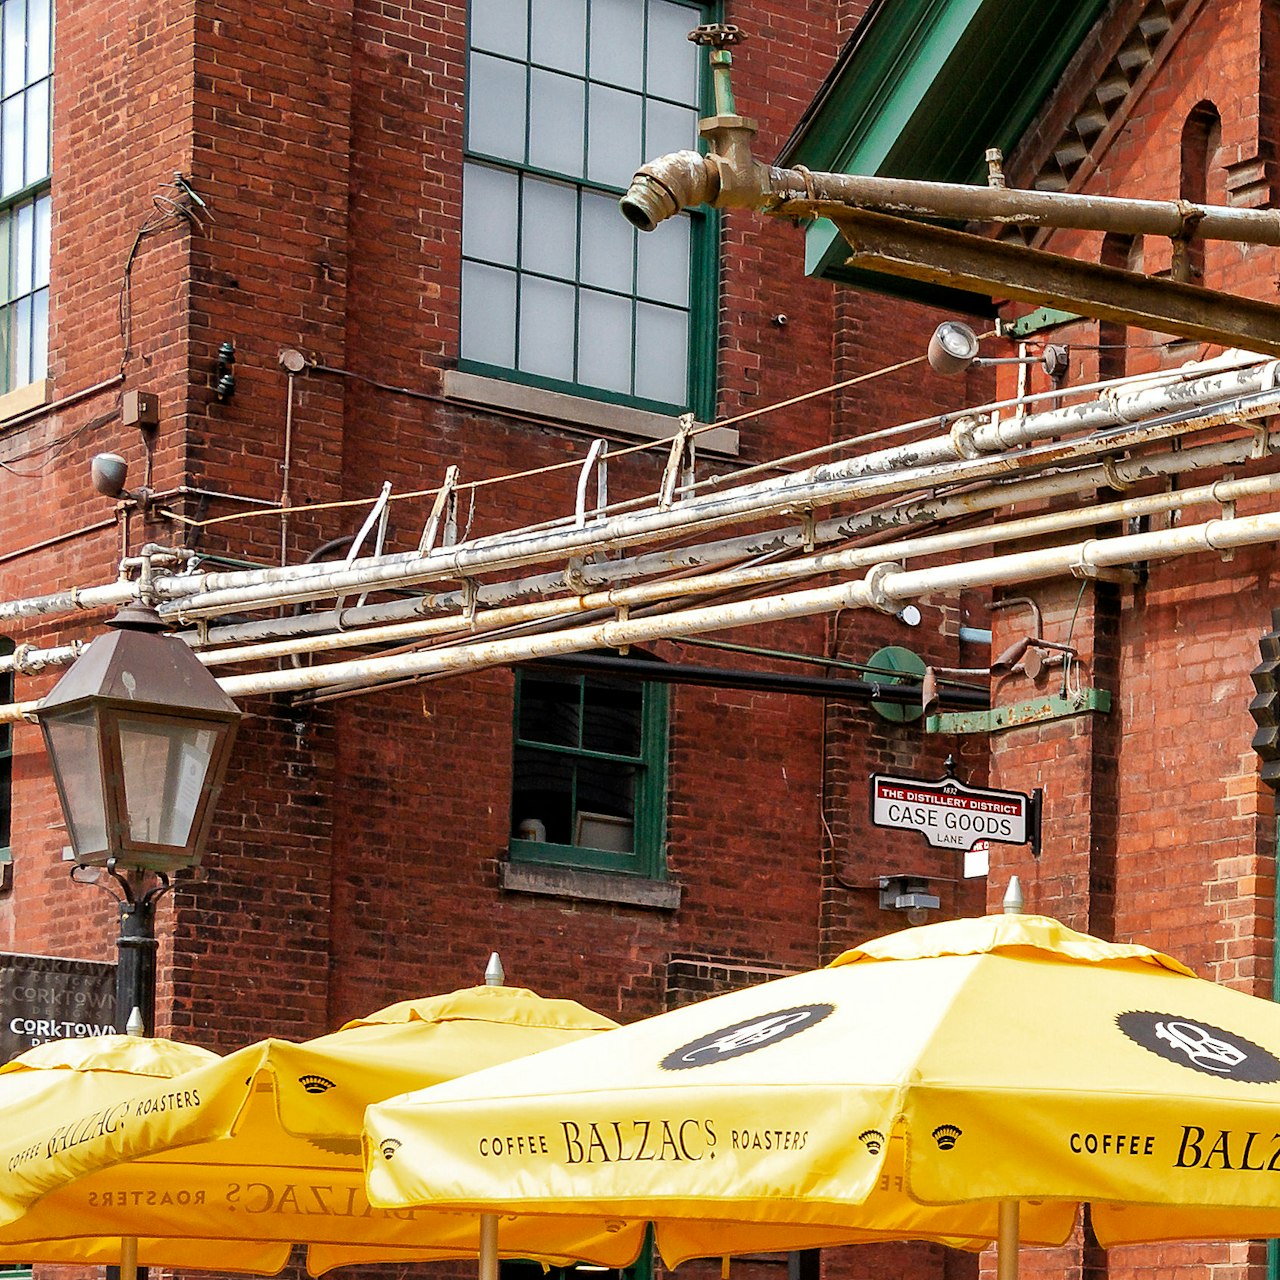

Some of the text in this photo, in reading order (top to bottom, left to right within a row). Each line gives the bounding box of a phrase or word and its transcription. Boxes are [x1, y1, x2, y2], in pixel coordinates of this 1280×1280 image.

[882, 788, 1018, 814] THE DISTILLERY DISTRICT
[888, 805, 1012, 835] CASE GOODS
[937, 833, 964, 845] LANE
[8, 1141, 41, 1172] COFFEE
[135, 1088, 201, 1117] ROASTERS
[479, 1135, 549, 1157] COFFEE
[731, 1129, 809, 1152] ROASTERS
[1069, 1132, 1156, 1157] COFFEE
